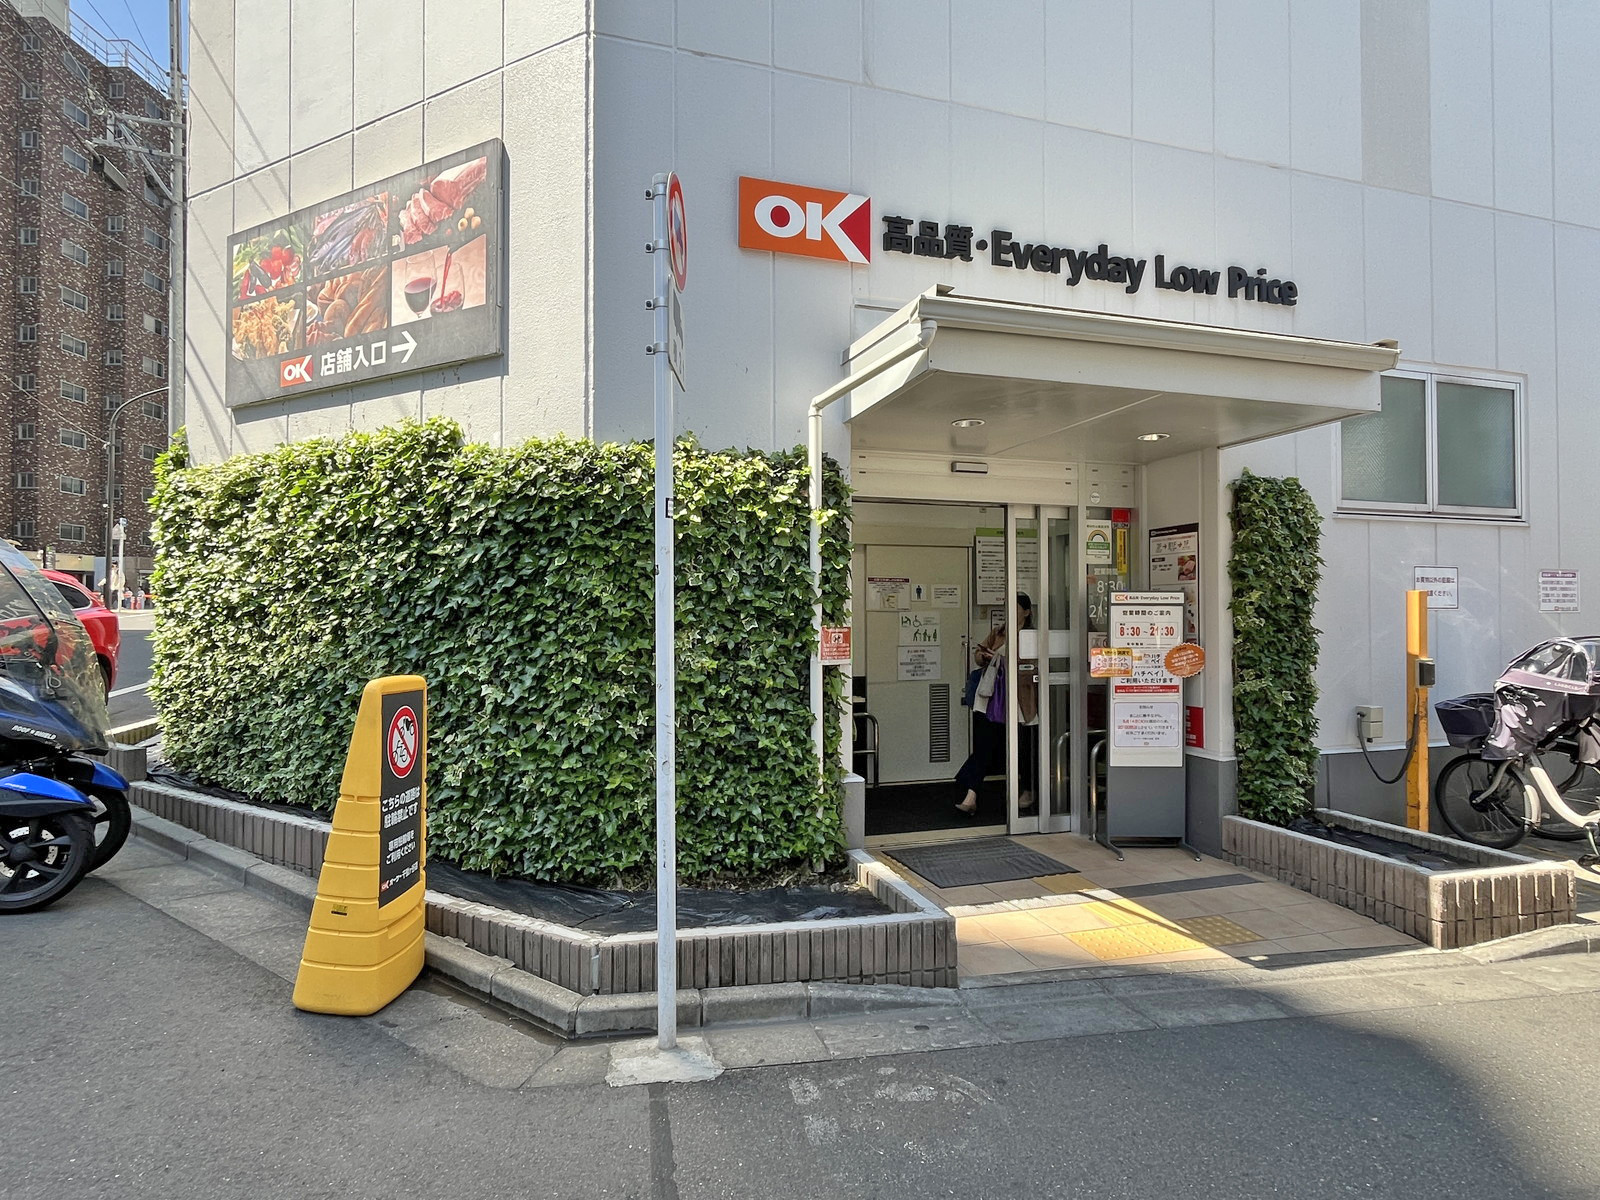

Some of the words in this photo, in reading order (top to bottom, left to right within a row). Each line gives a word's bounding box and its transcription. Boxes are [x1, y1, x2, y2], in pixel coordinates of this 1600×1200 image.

[754, 193, 871, 264] OK
[1155, 255, 1221, 295] Low
[1228, 266, 1299, 306] Price
[283, 354, 313, 382] OK
[320, 341, 387, 377] 店舗入口
